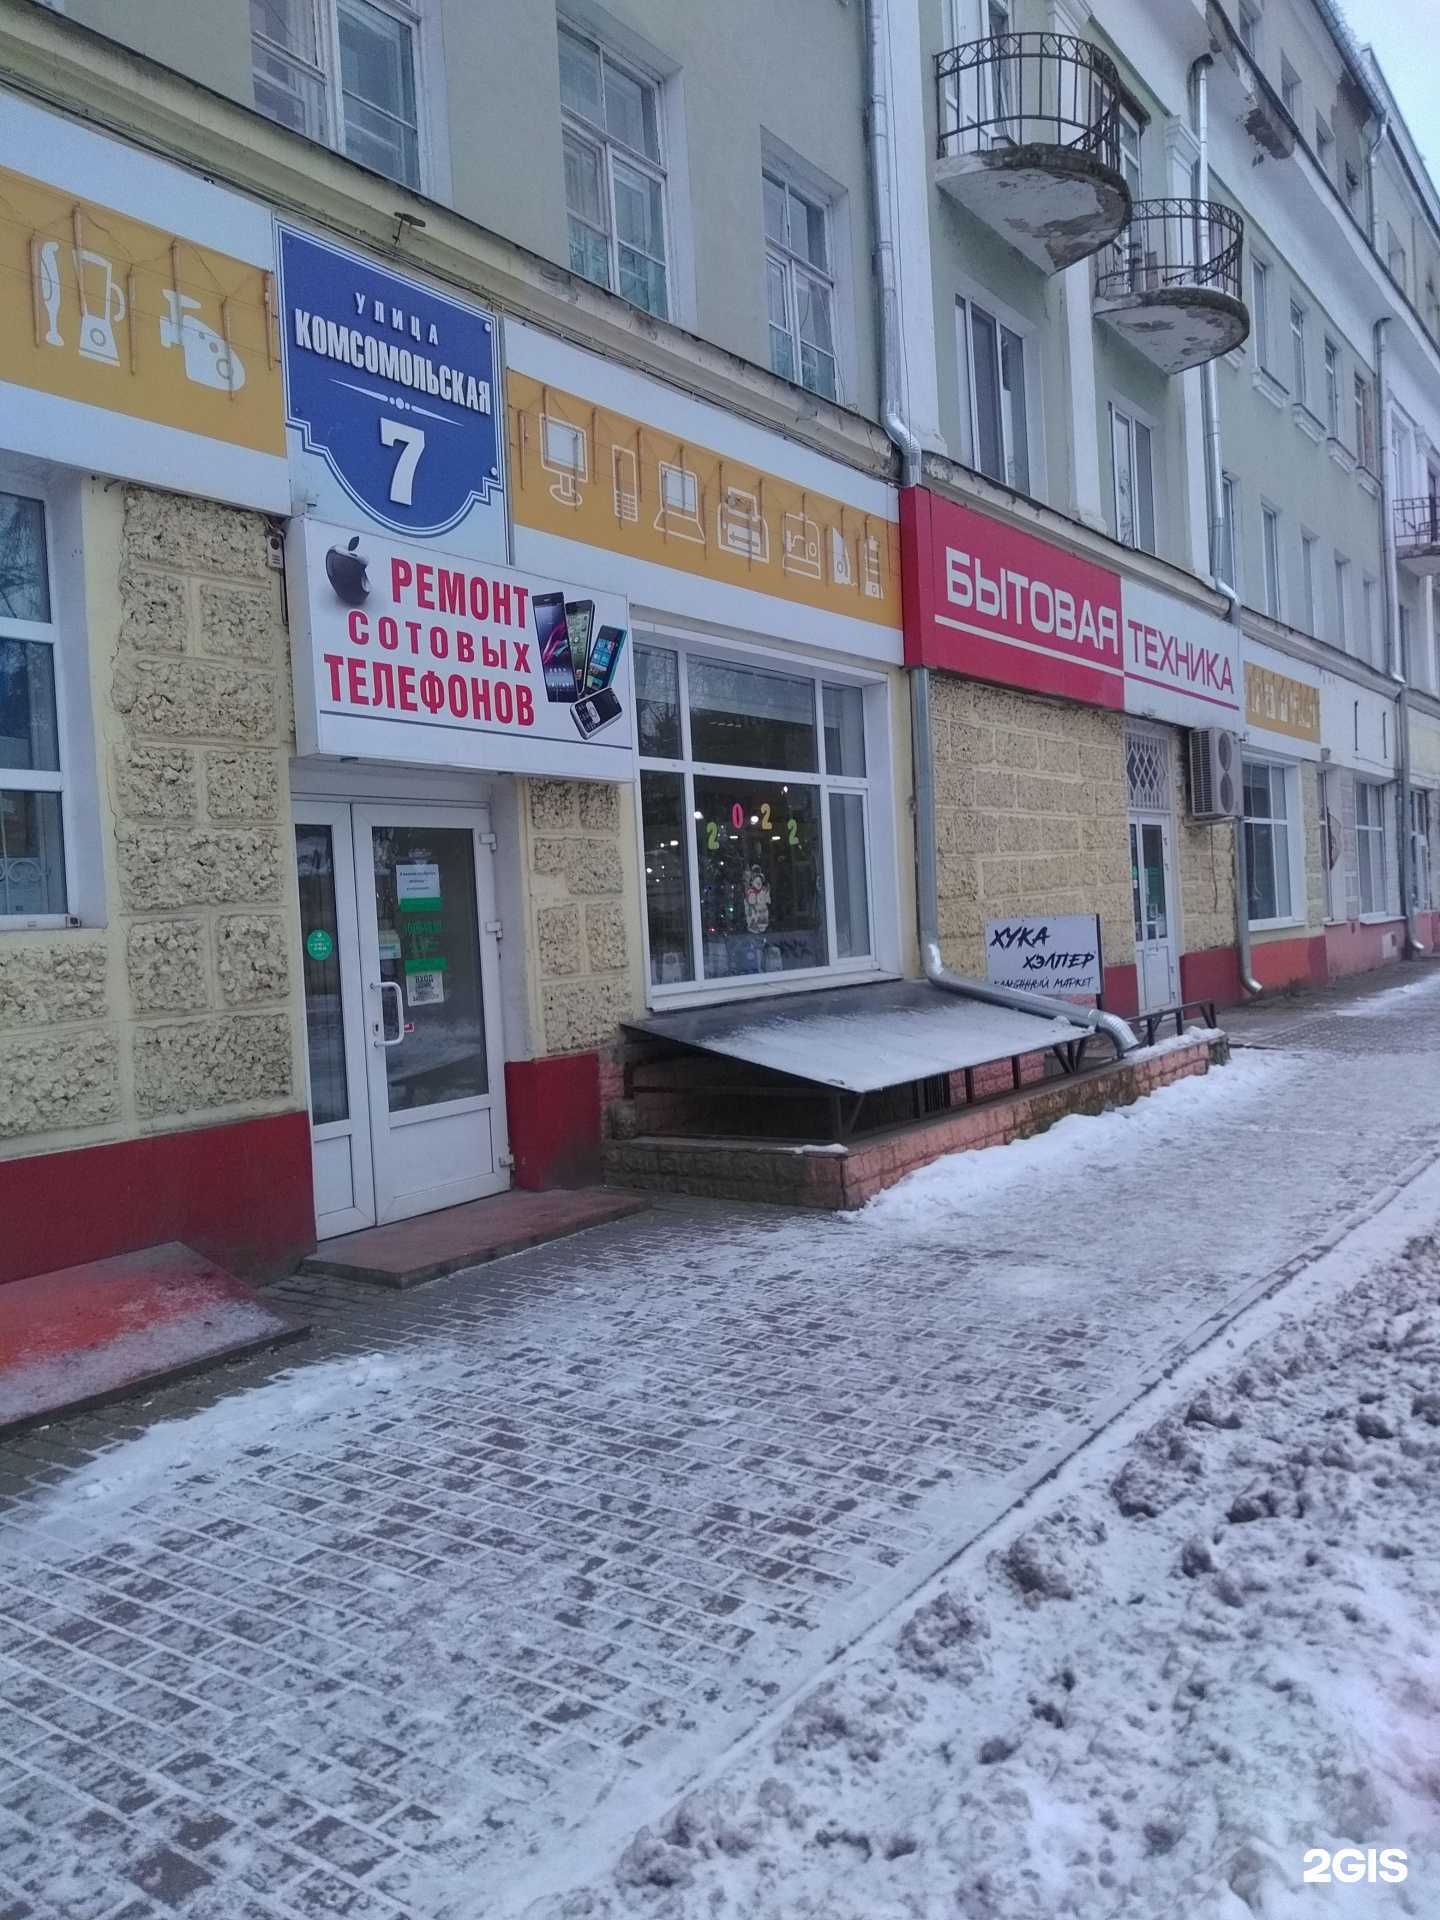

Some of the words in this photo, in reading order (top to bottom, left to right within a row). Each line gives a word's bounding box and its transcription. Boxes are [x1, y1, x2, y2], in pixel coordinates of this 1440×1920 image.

[355, 292, 439, 346] УЛИЦА
[295, 308, 491, 415] КОМСОМОЛЬСКАЯ
[380, 417, 425, 506] 7
[390, 557, 529, 629] РЕМОНТ
[945, 546, 1119, 655] БЫТОВАЯ
[1127, 618, 1235, 695] ТЕХНИКА
[348, 610, 532, 674] СОТОВЫХ
[323, 653, 535, 727] ТЕЛЕФОНОВ
[990, 926, 1050, 951] ХУКА
[1022, 951, 1095, 971] ХЭЛПЕР
[1053, 977, 1094, 989] МАРКЕТ
